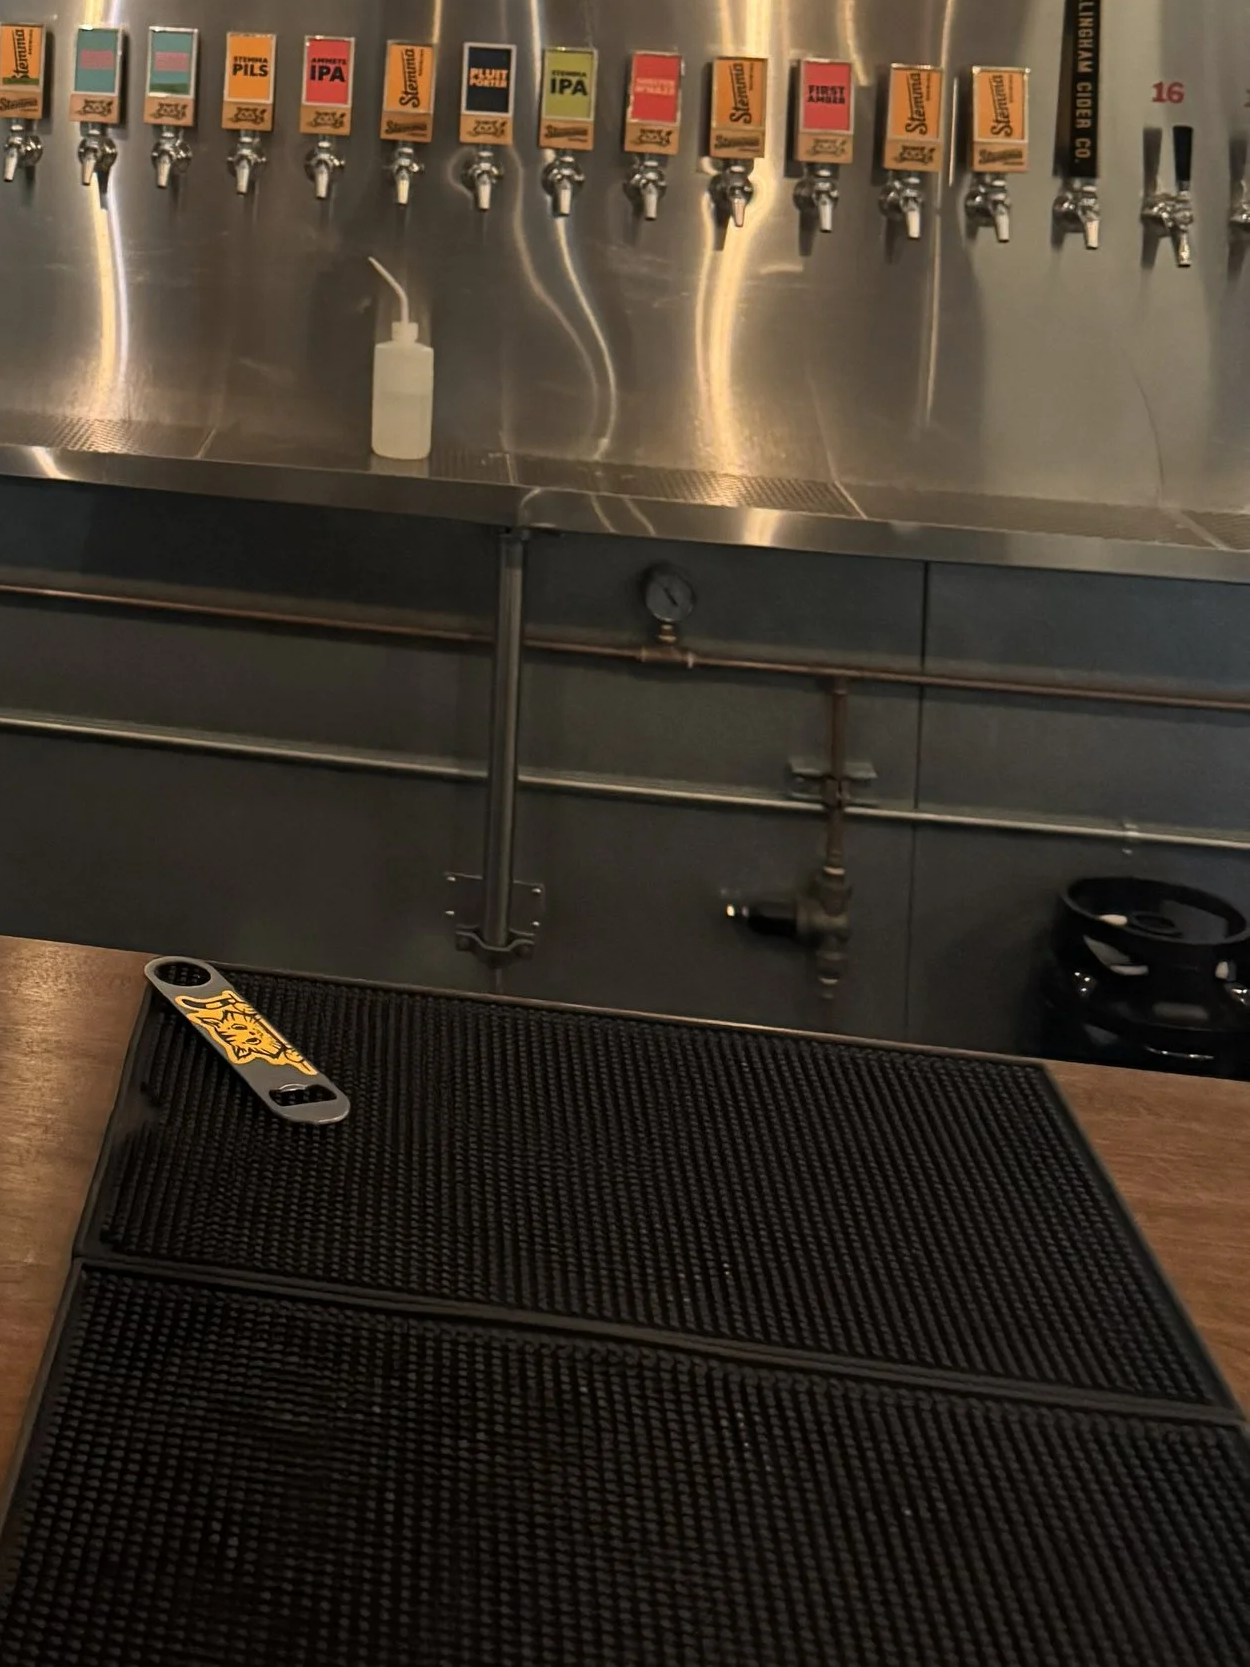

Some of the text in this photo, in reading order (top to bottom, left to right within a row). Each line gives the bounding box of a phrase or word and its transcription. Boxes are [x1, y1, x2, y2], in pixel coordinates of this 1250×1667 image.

[232, 63, 269, 78] PILS
[310, 65, 346, 83] IPA
[399, 48, 421, 108] Stemma
[550, 78, 588, 96] IPA
[729, 63, 752, 124] Stemma
[808, 85, 845, 96] FIRST
[905, 72, 928, 136] Stemma
[989, 74, 1013, 137] Stemma
[1075, 81, 1093, 129] CIDER
[1152, 81, 1185, 104] 16
